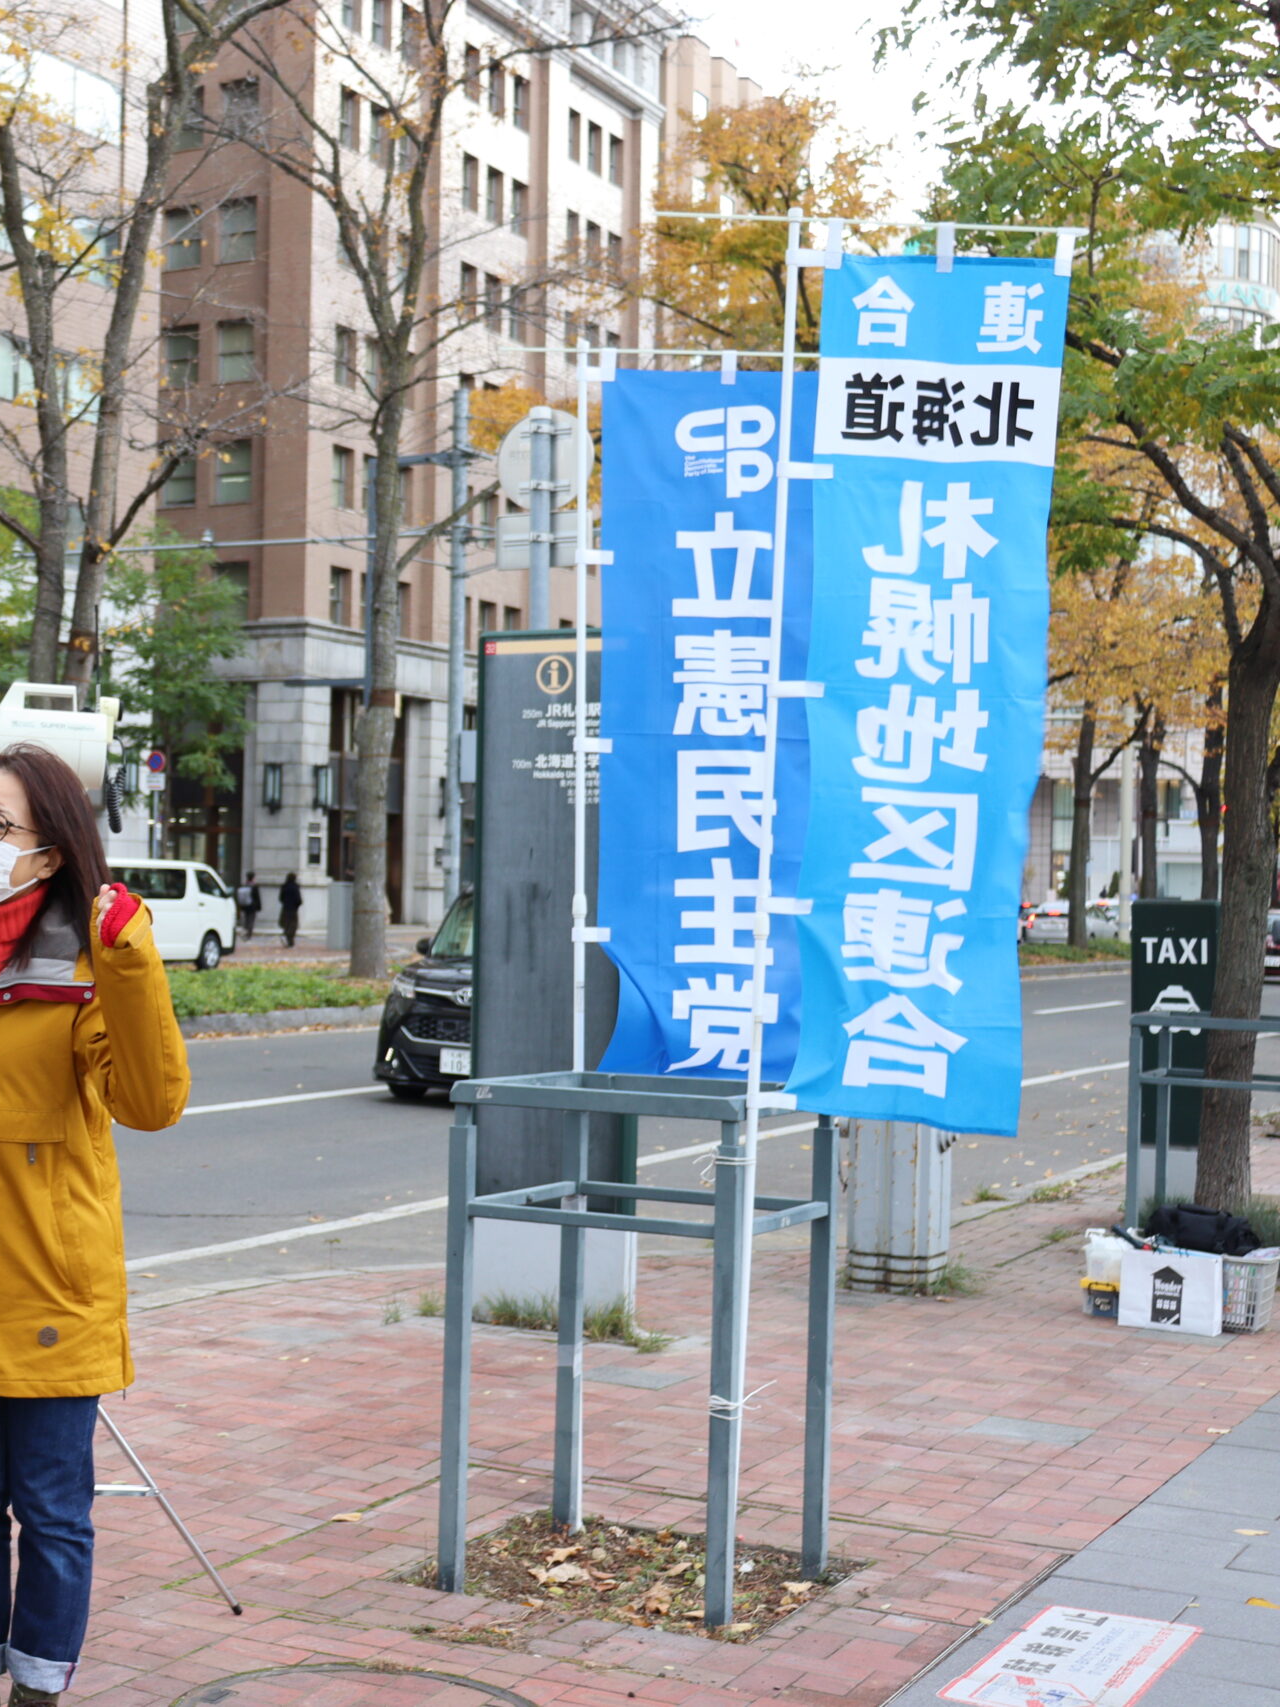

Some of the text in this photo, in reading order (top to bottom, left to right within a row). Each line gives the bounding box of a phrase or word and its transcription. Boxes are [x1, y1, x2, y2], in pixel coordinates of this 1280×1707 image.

[522, 709, 543, 719] 250m
[512, 760, 532, 769] 700m
[664, 511, 780, 1073] 立憲民主党
[1140, 937, 1209, 965] TAXI
